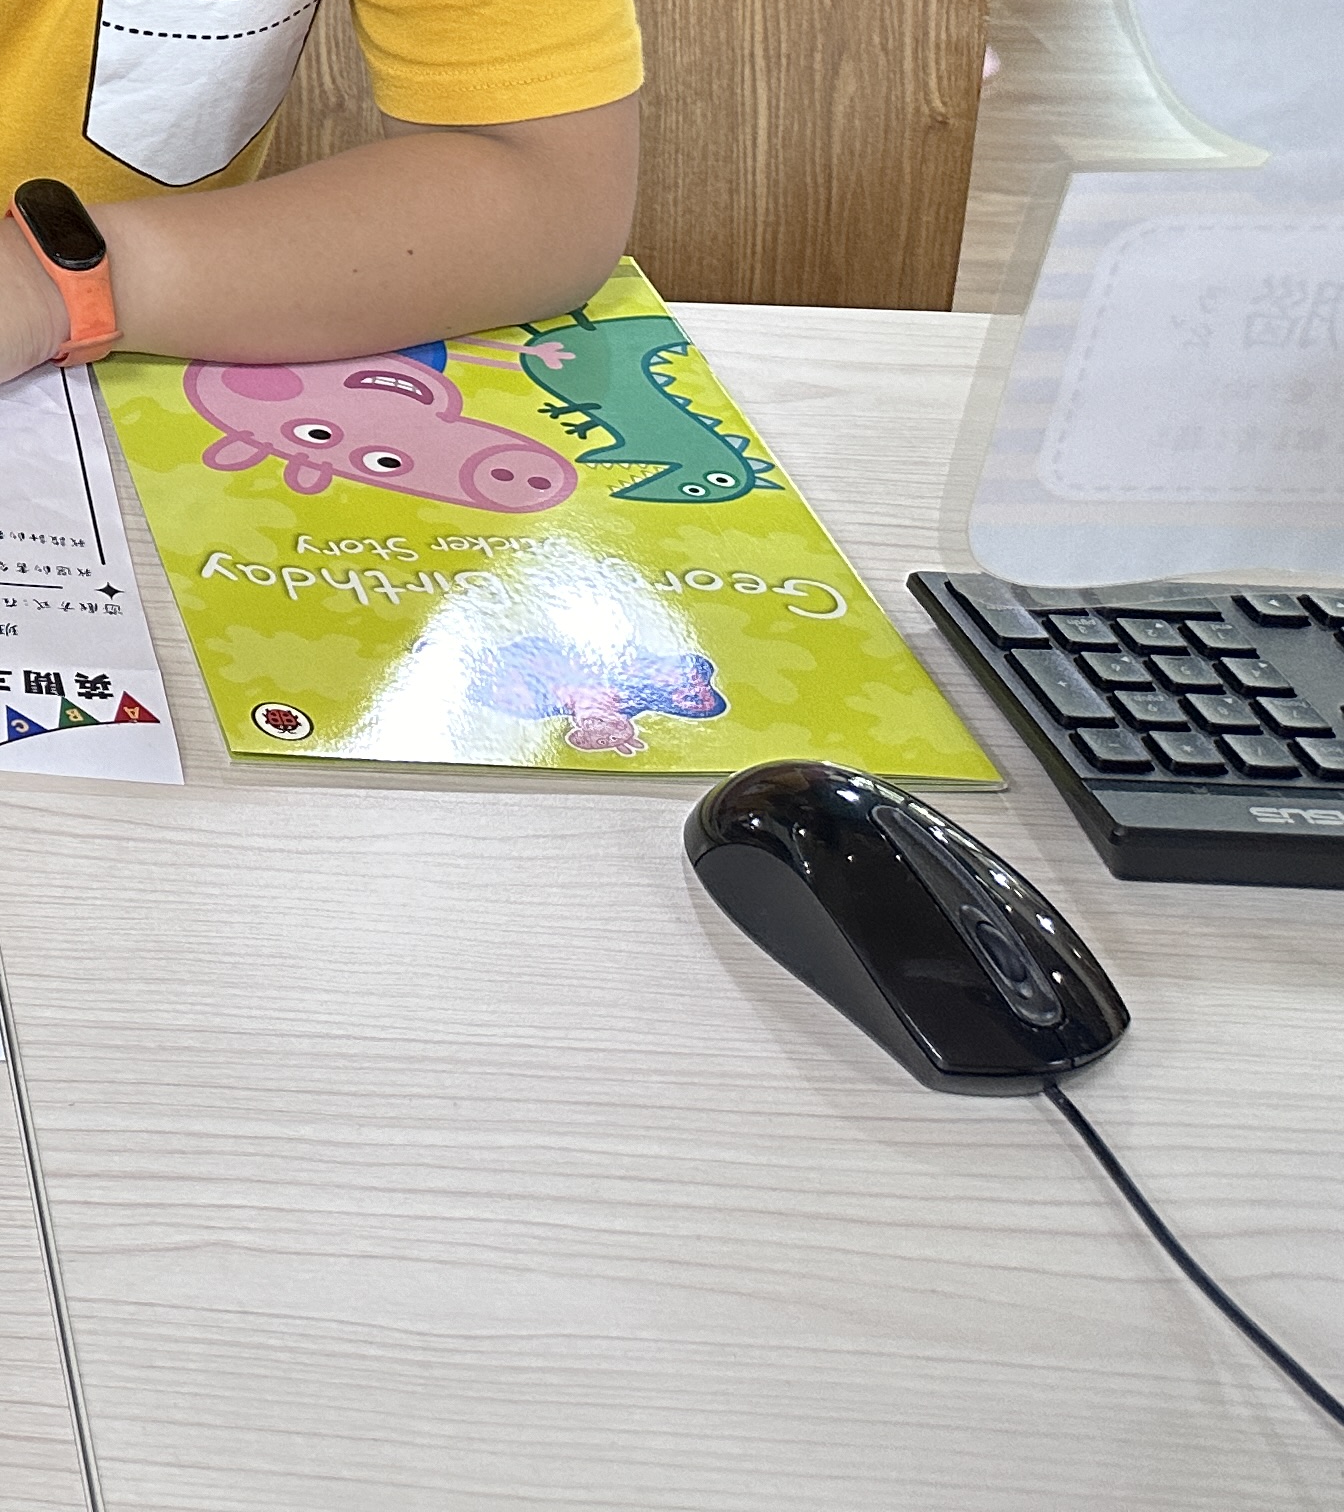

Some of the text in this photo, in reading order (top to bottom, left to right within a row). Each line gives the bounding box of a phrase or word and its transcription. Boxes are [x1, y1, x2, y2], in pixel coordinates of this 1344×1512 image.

[289, 534, 423, 562] Story
[10, 705, 139, 734] A B C
